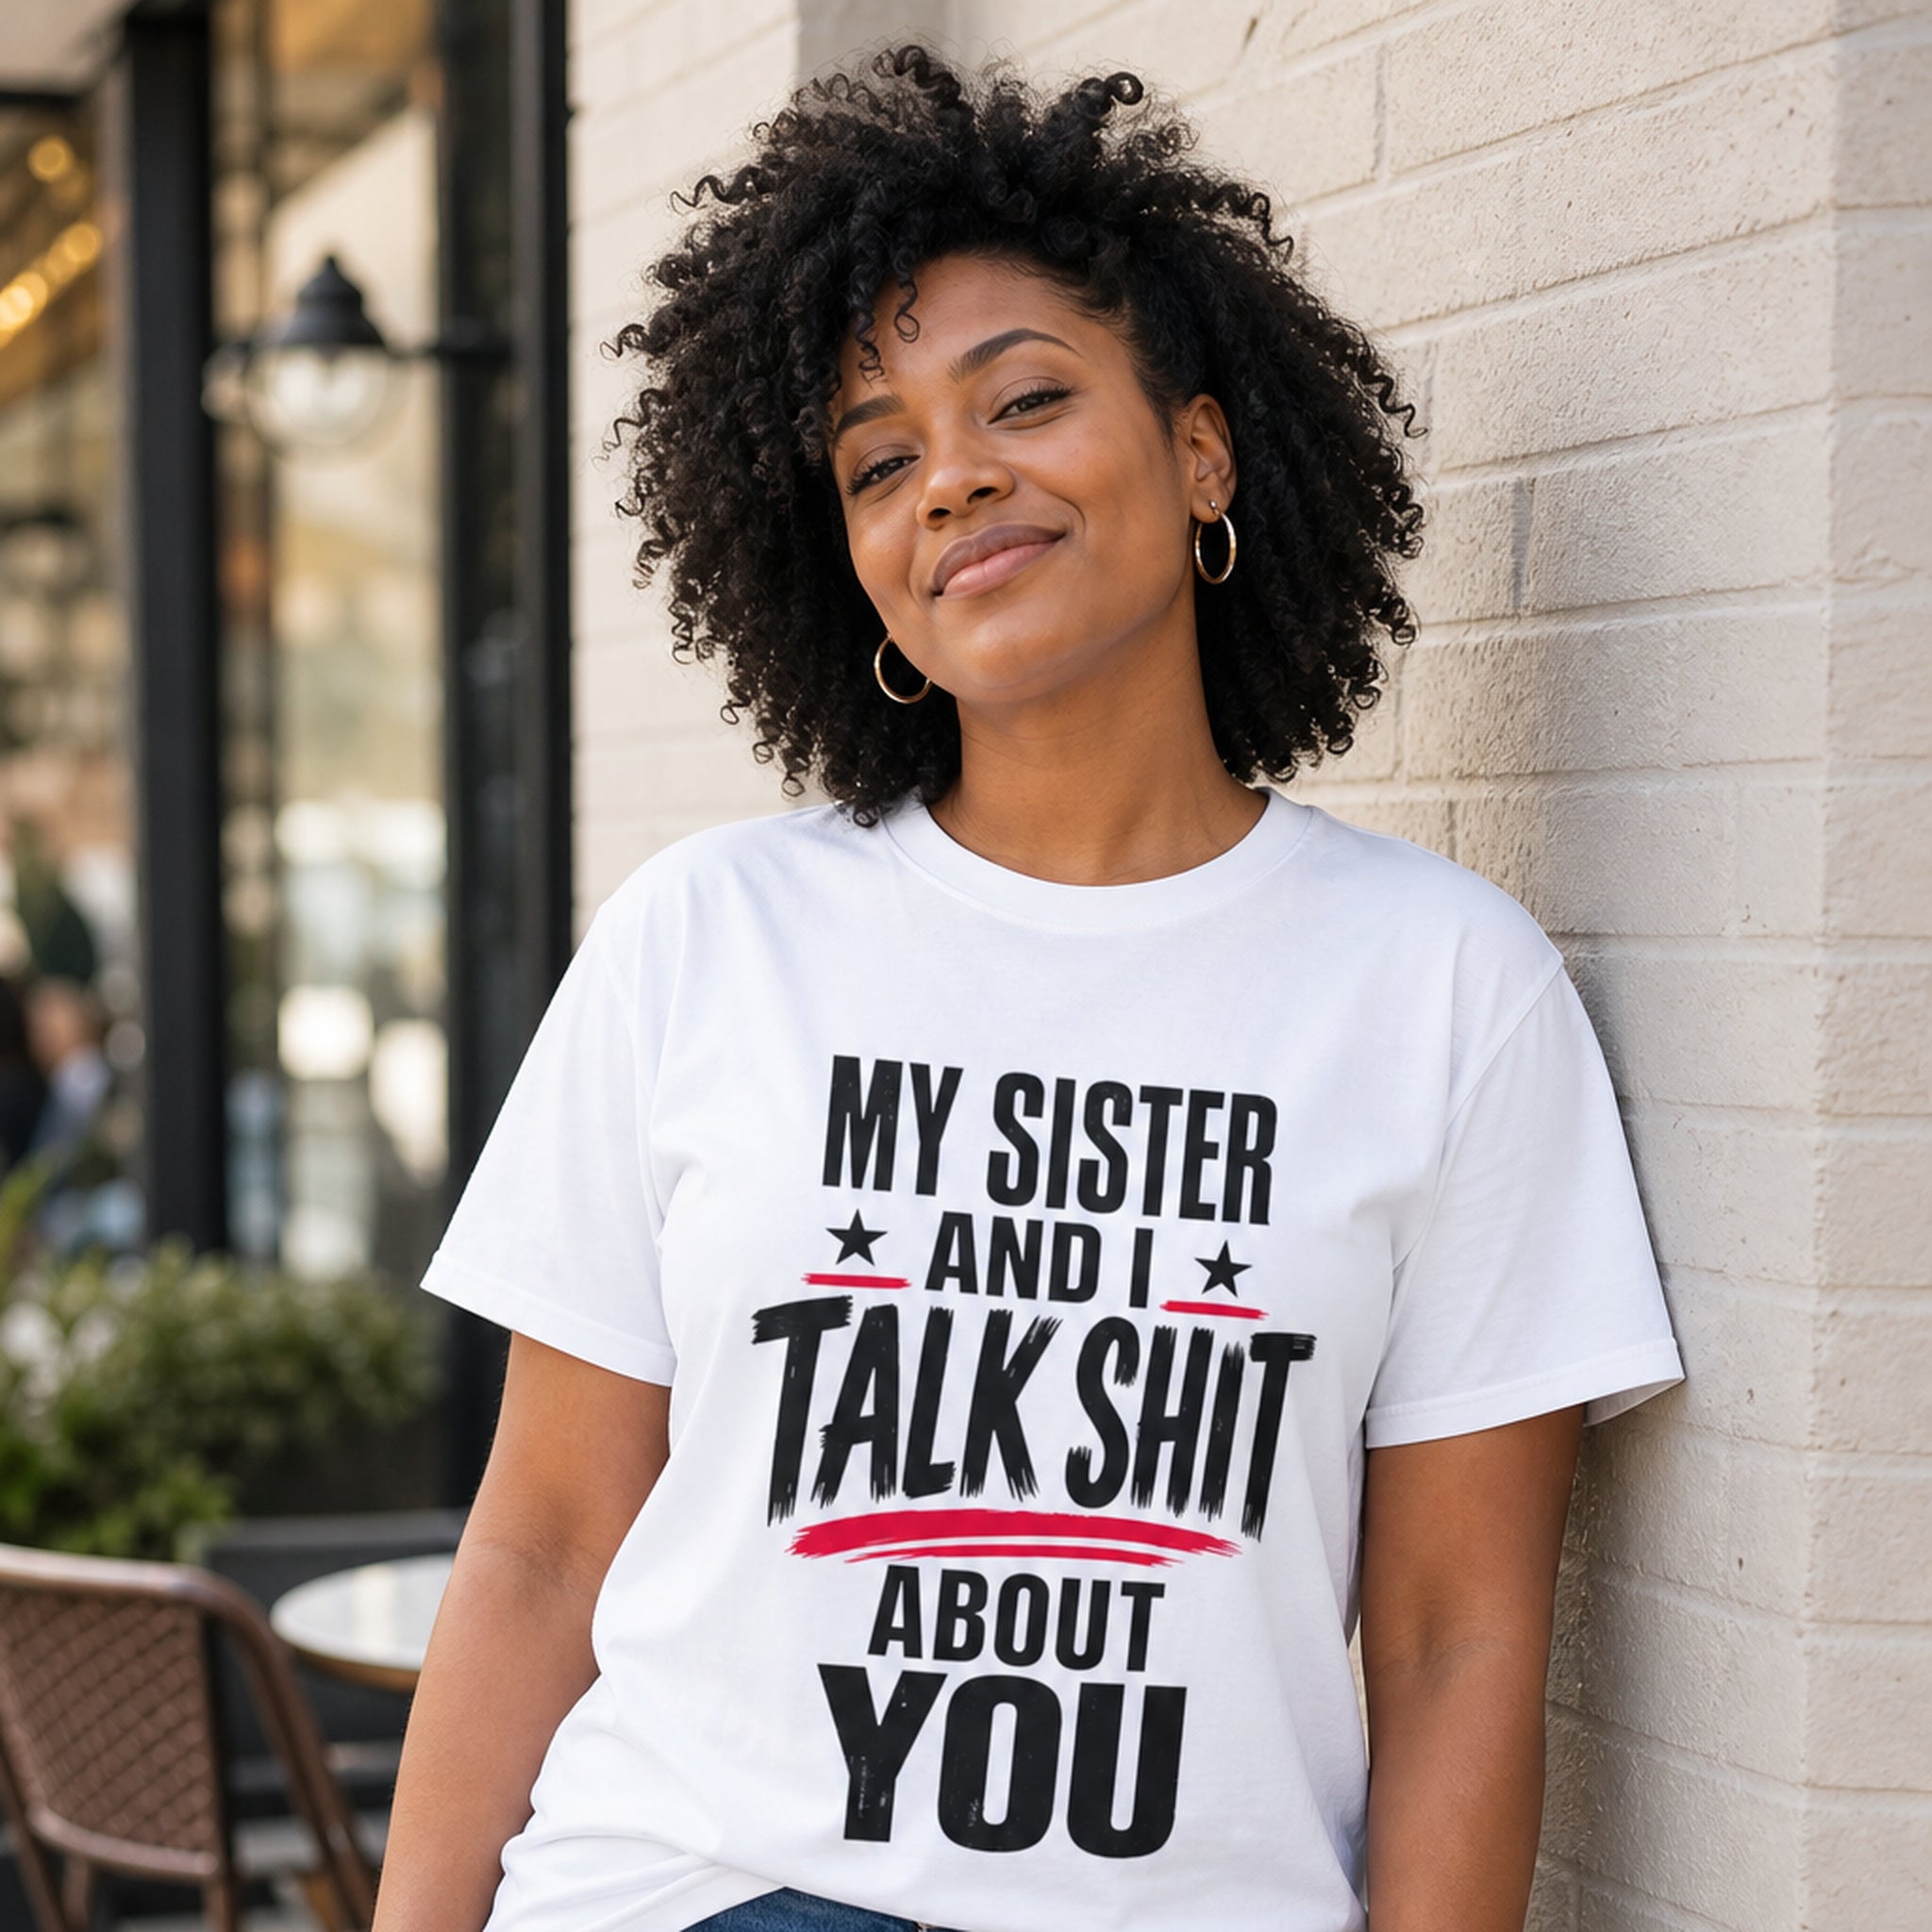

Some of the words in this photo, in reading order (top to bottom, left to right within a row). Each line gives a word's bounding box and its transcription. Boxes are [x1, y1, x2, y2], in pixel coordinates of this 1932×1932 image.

[822, 1055, 963, 1196] MY
[986, 1072, 1277, 1225] SISTER
[924, 1211, 1102, 1304] AND
[1129, 1227, 1154, 1309] I
[751, 1295, 1062, 1526] TALK
[1065, 1316, 1318, 1542] SHIT
[867, 1564, 1166, 1673] ABOUT
[817, 1663, 1188, 1859] YOU
